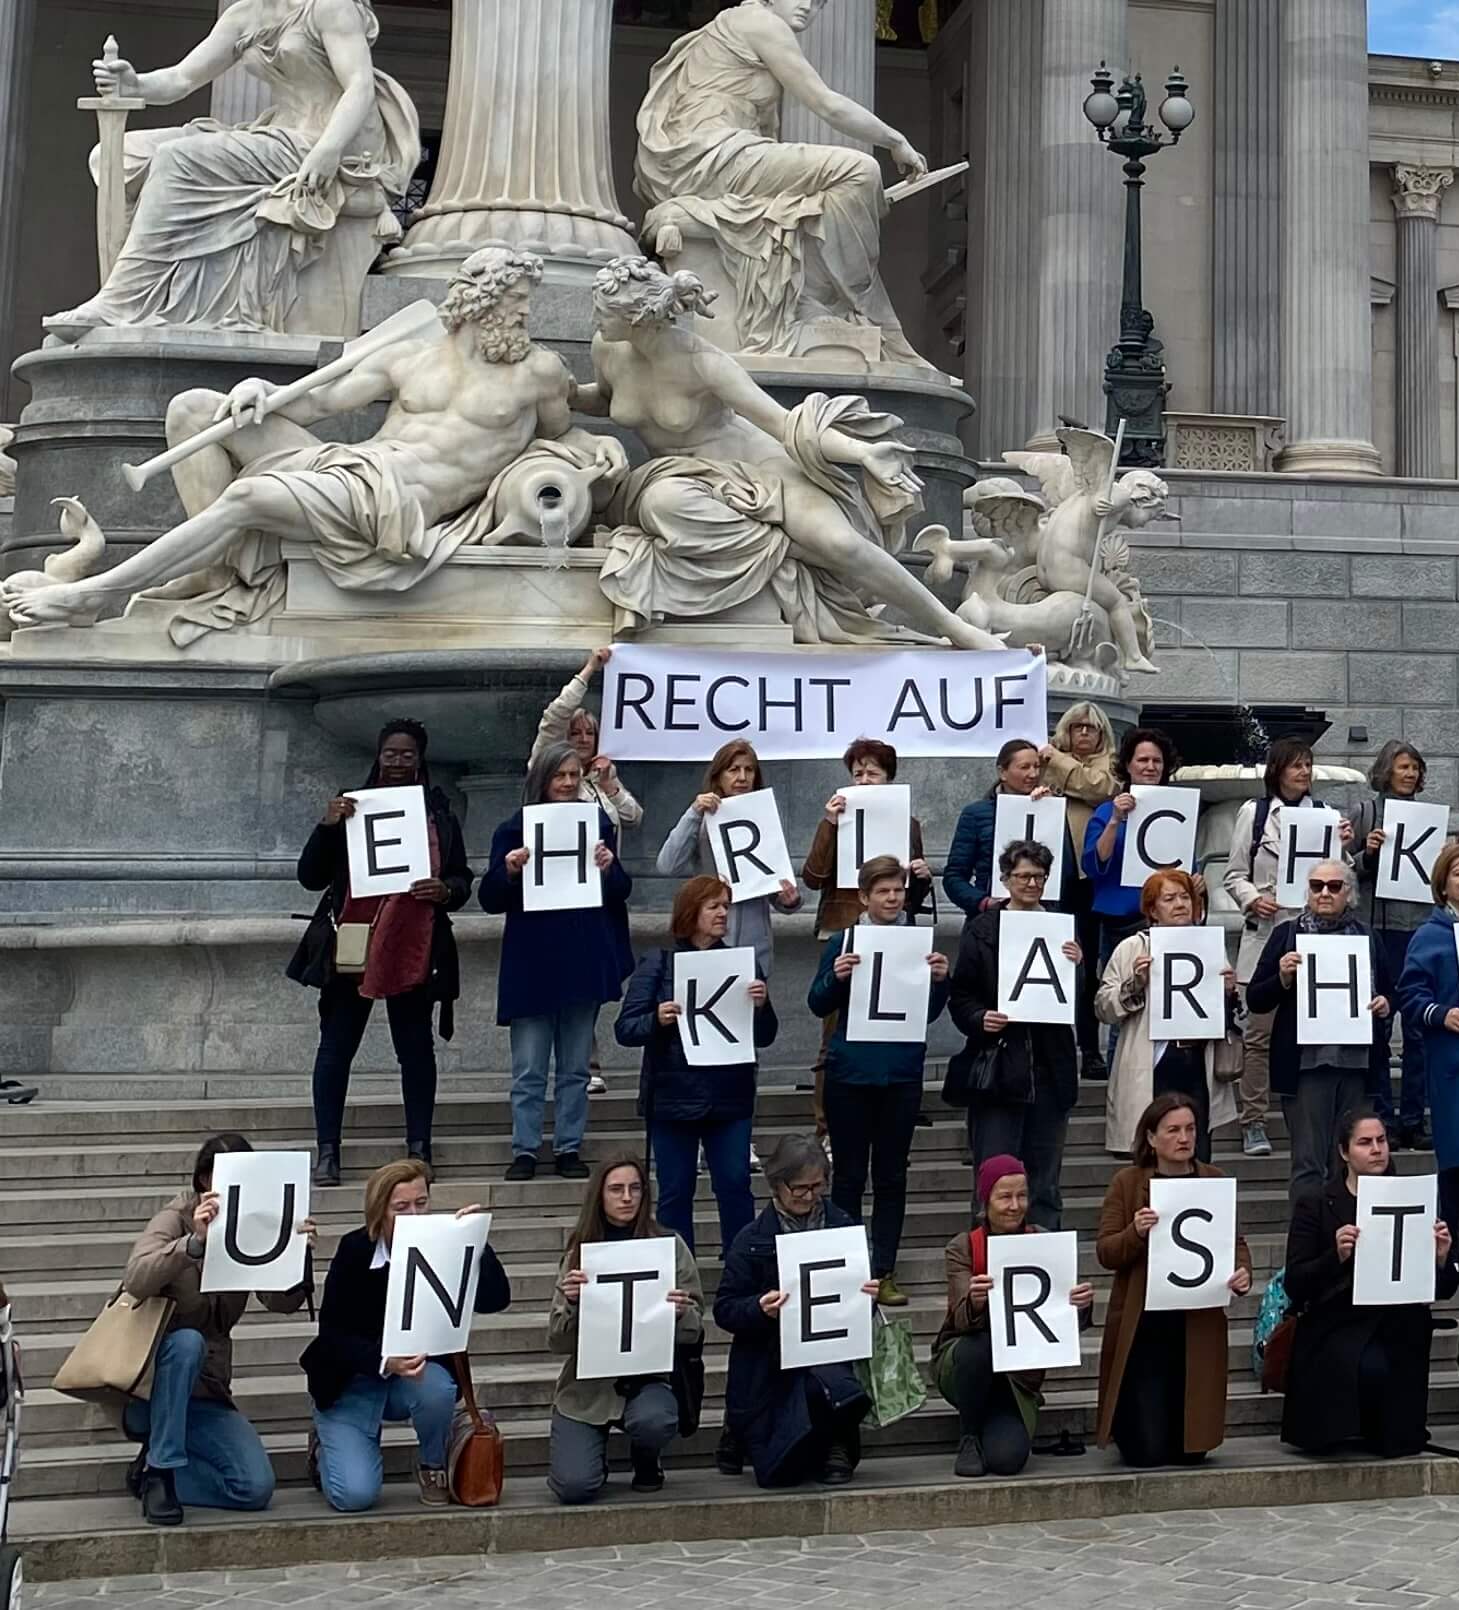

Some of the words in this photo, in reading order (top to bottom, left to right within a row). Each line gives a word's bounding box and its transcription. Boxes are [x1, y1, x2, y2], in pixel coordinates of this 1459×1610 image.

[615, 673, 850, 732] RECHT
[887, 675, 1027, 731] AUF
[365, 811, 409, 876] E
[535, 821, 586, 885] H
[719, 819, 775, 883] R
[1137, 809, 1186, 870] C
[1287, 825, 1333, 885] H
[1391, 823, 1438, 885] K
[869, 952, 906, 1021] L
[1009, 937, 1067, 1003] A
[1163, 953, 1208, 1019] R
[1308, 954, 1358, 1018] H
[687, 975, 739, 1045] K
[225, 1184, 295, 1266] U
[1167, 1209, 1213, 1287] S
[1372, 1205, 1425, 1281] T
[401, 1246, 474, 1331] N
[597, 1271, 659, 1352] T
[800, 1259, 848, 1342] E
[1003, 1266, 1059, 1346] R
